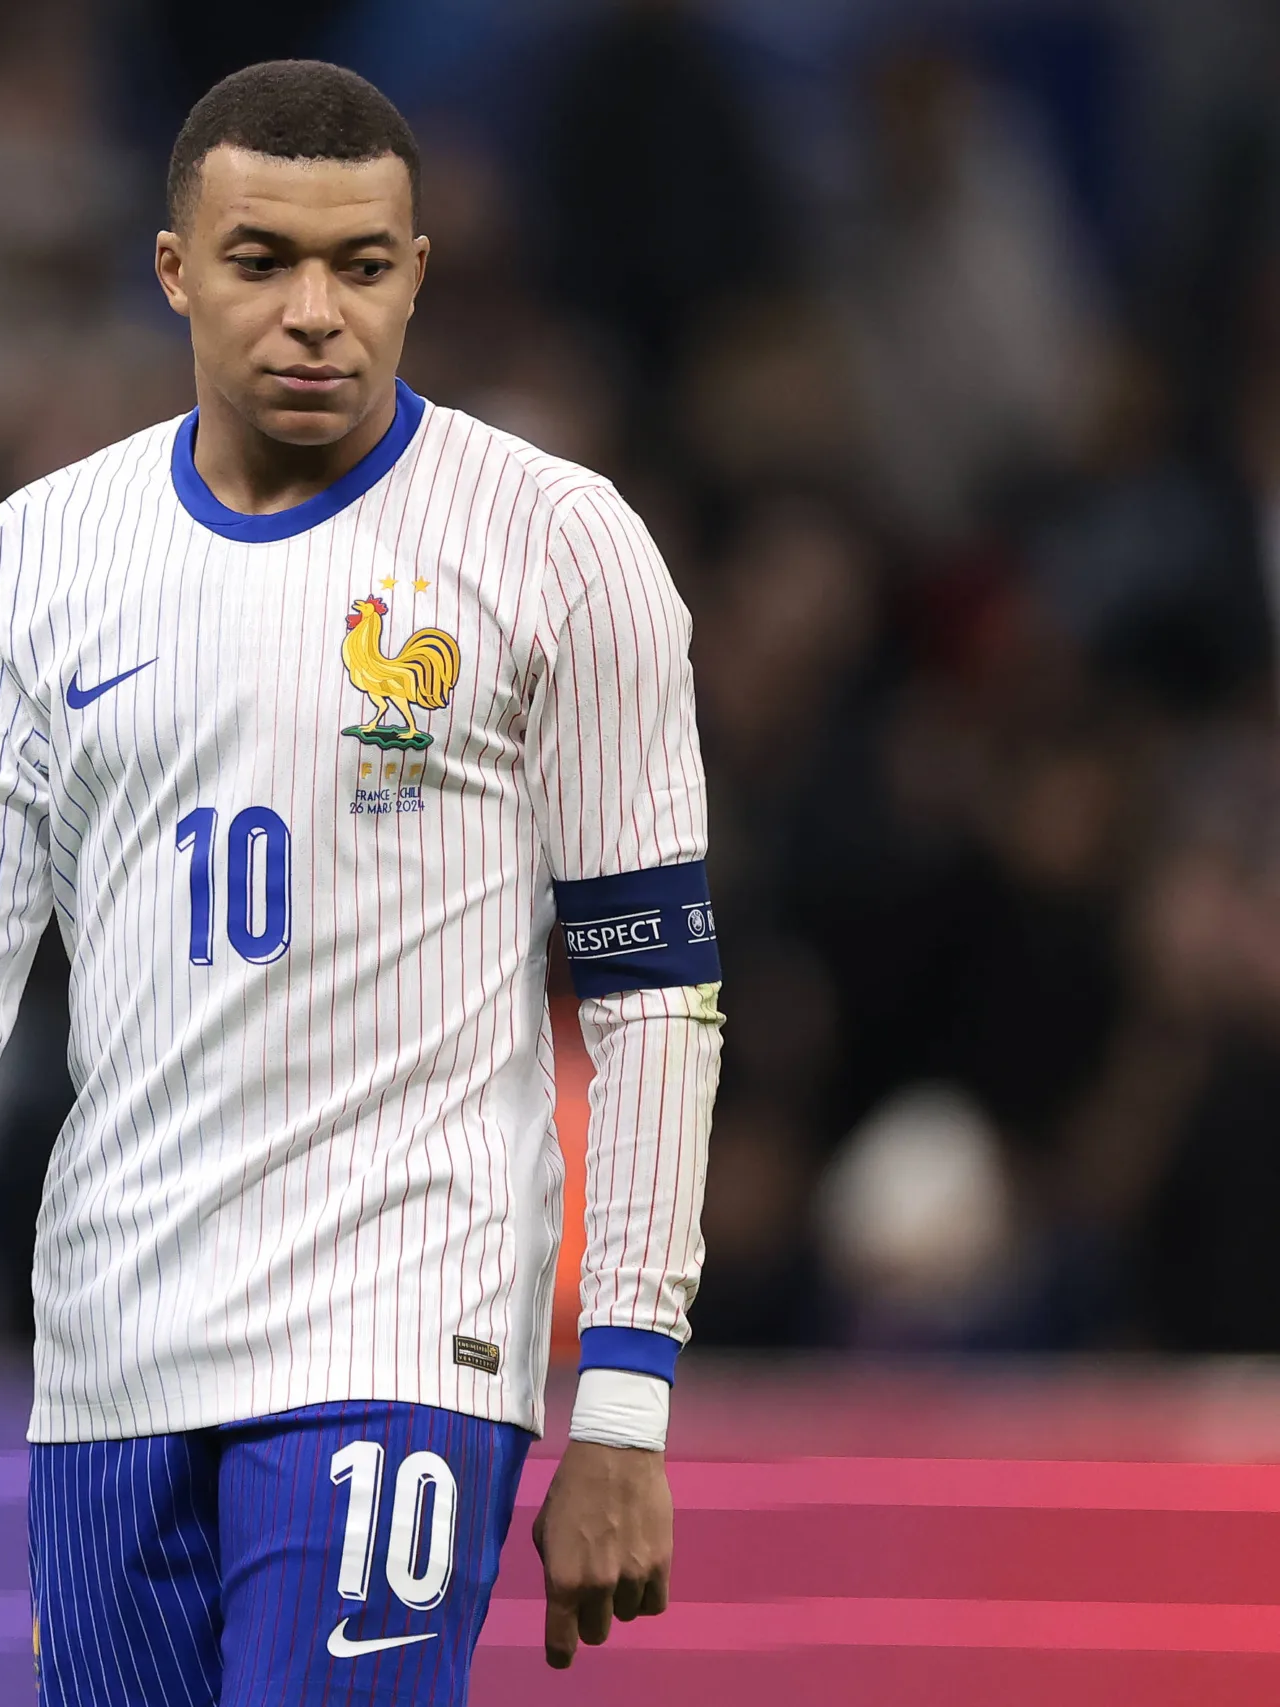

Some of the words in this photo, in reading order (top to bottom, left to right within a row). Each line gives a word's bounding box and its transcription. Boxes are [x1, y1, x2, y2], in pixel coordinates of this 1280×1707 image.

[349, 802, 364, 814] 26
[367, 802, 393, 814] MARS
[396, 800, 425, 813] 2024
[356, 789, 390, 801] FRANCE
[176, 806, 291, 966] 10
[567, 917, 662, 952] RESPECT
[329, 1440, 458, 1611] 10
